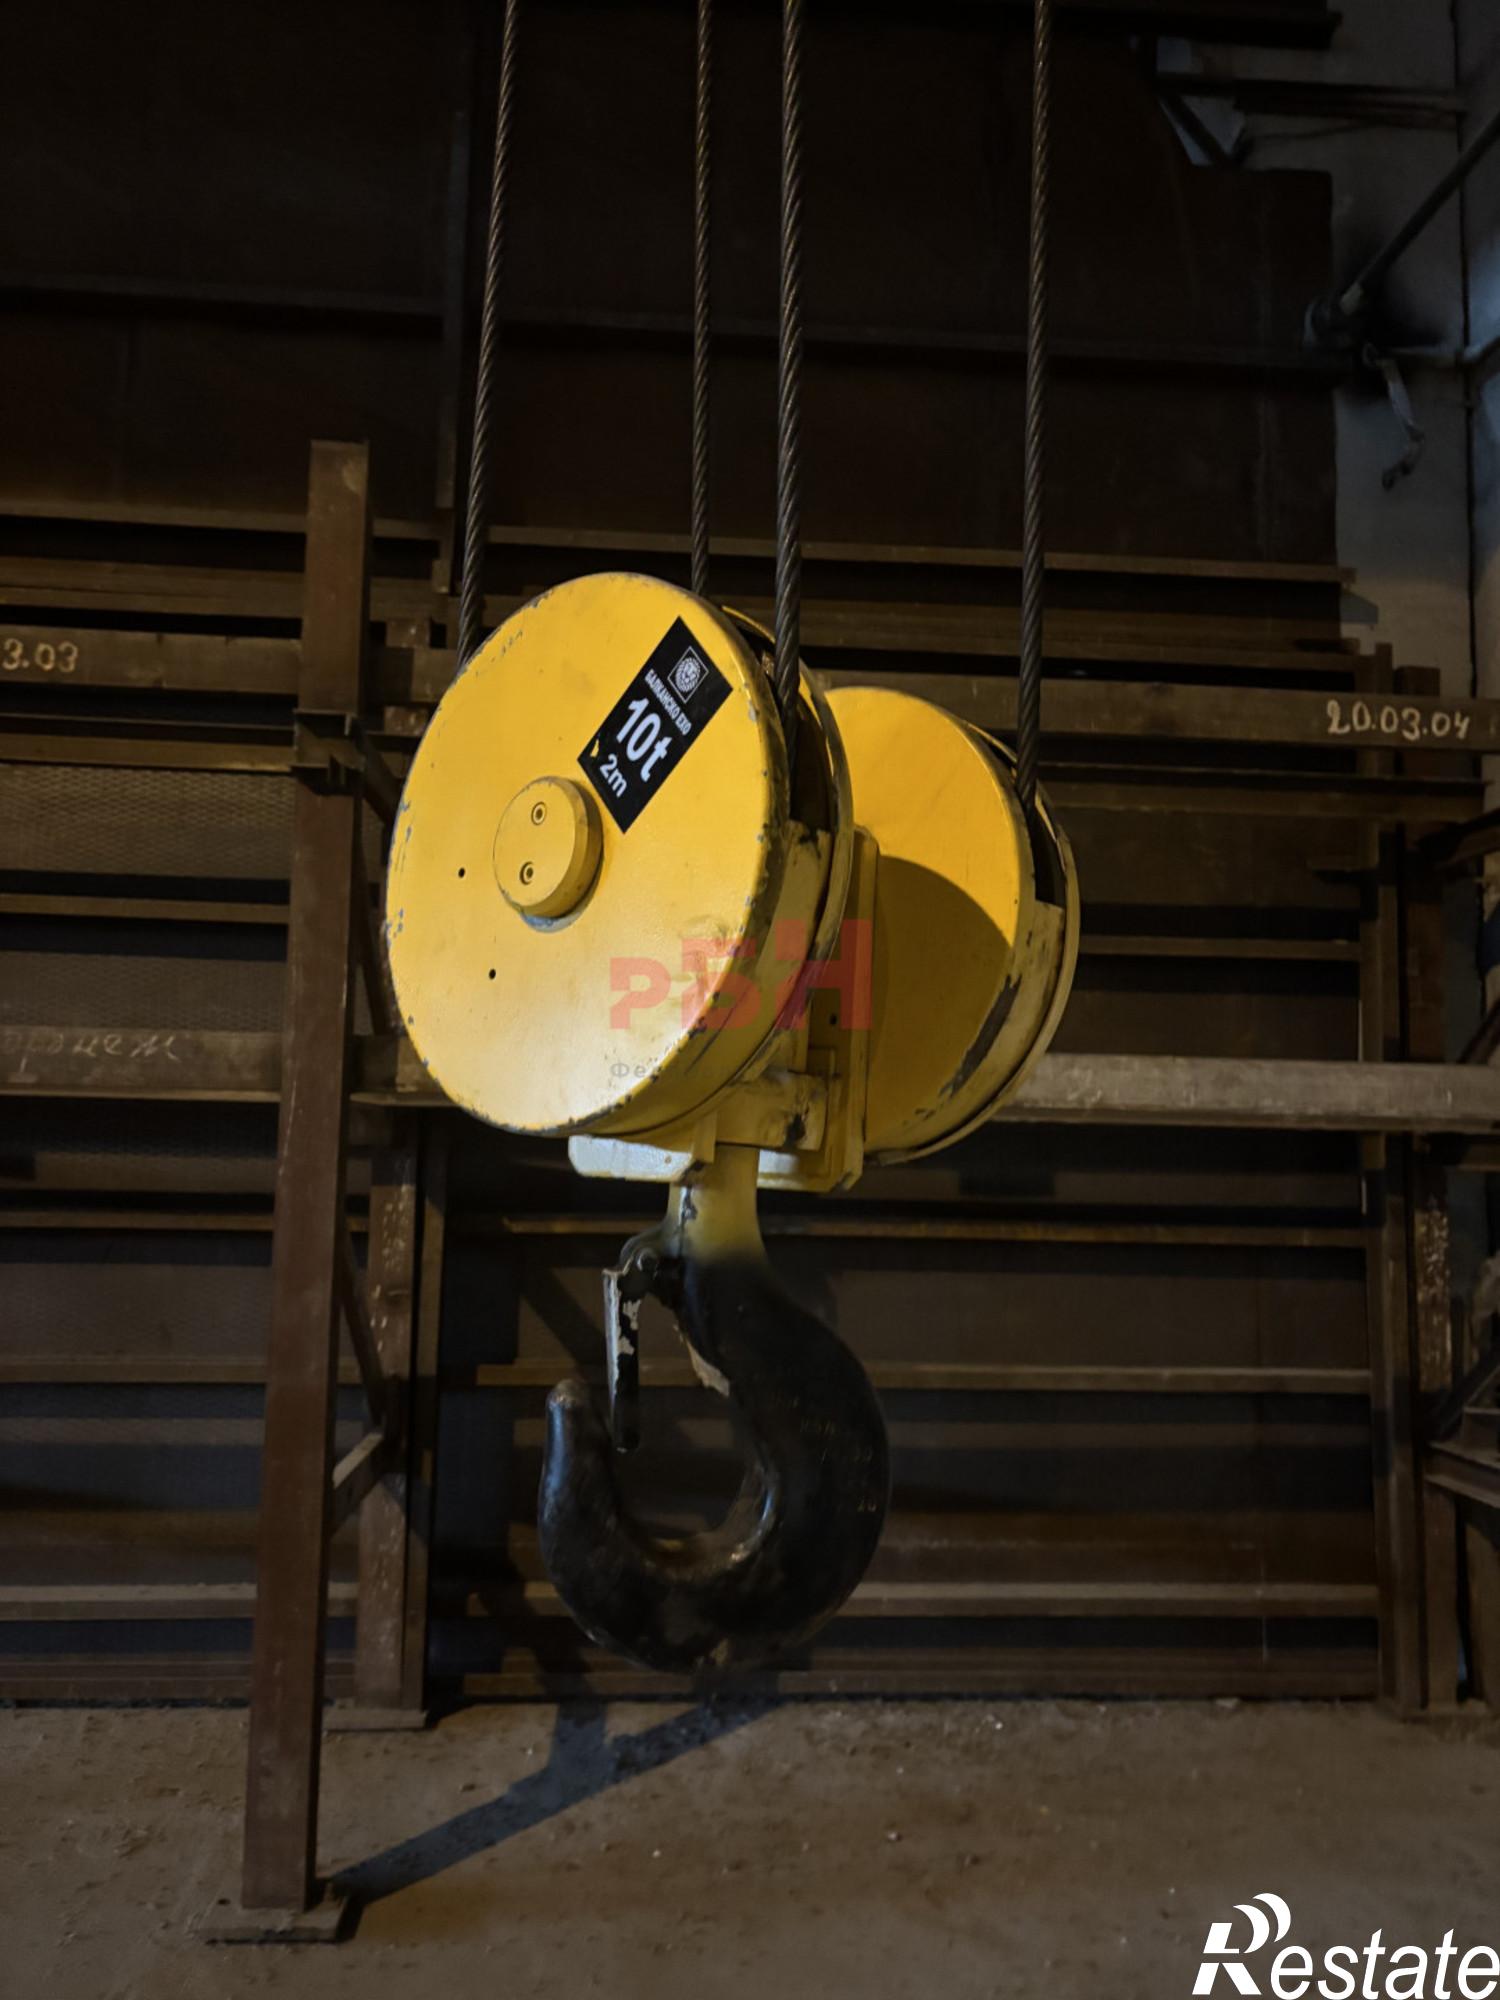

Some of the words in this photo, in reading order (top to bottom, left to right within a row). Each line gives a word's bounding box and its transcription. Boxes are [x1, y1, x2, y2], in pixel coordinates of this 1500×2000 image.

[616, 697, 673, 782] 10t
[1326, 699, 1471, 742] 20.03.04
[599, 753, 628, 798] 2m
